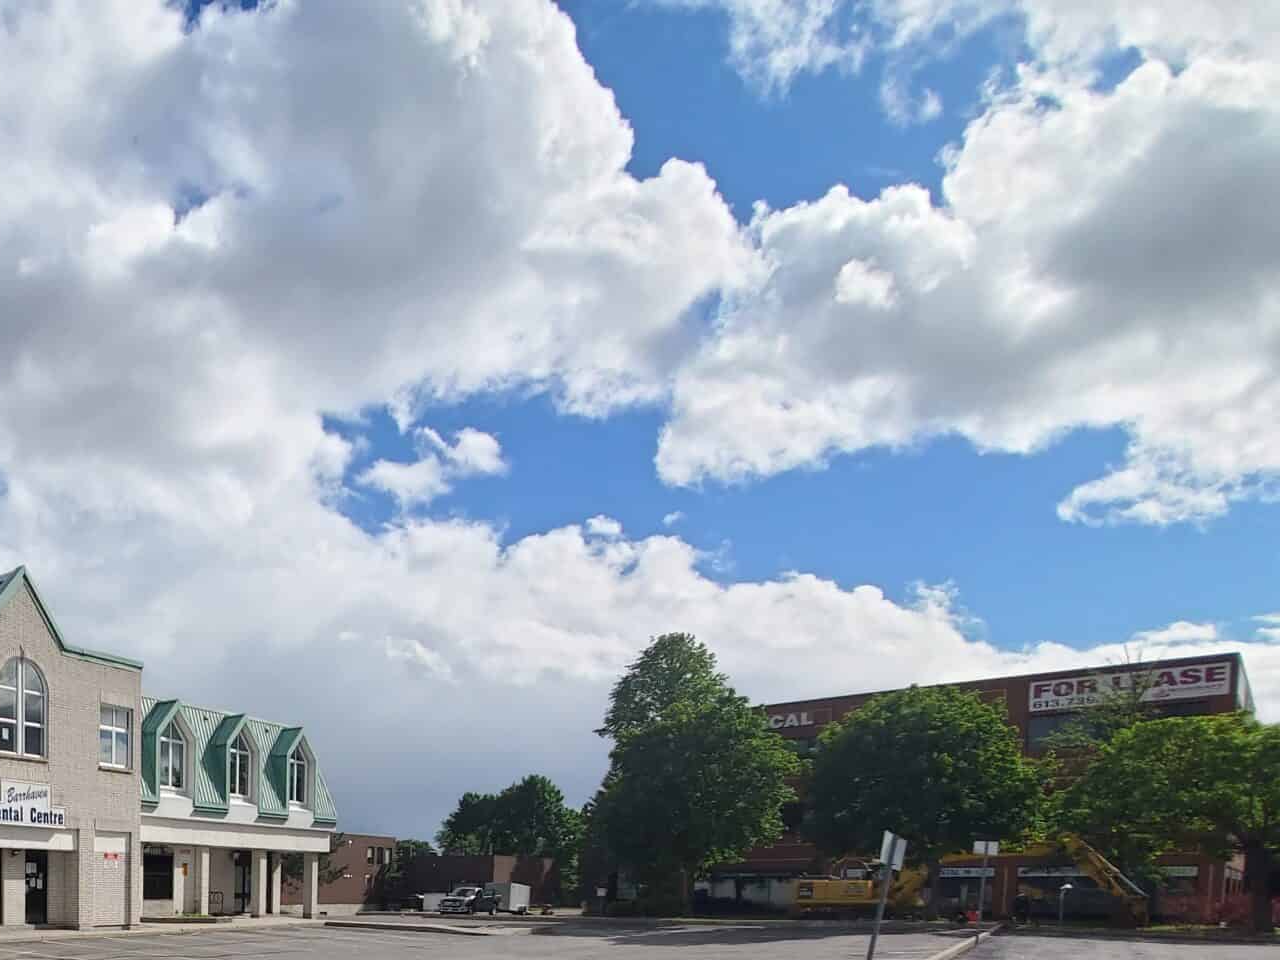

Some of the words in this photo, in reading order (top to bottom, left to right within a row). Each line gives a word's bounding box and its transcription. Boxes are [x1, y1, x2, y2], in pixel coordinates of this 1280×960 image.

[1033, 678, 1097, 698] FOR
[770, 711, 814, 729] CAL
[31, 807, 64, 824] Centre
